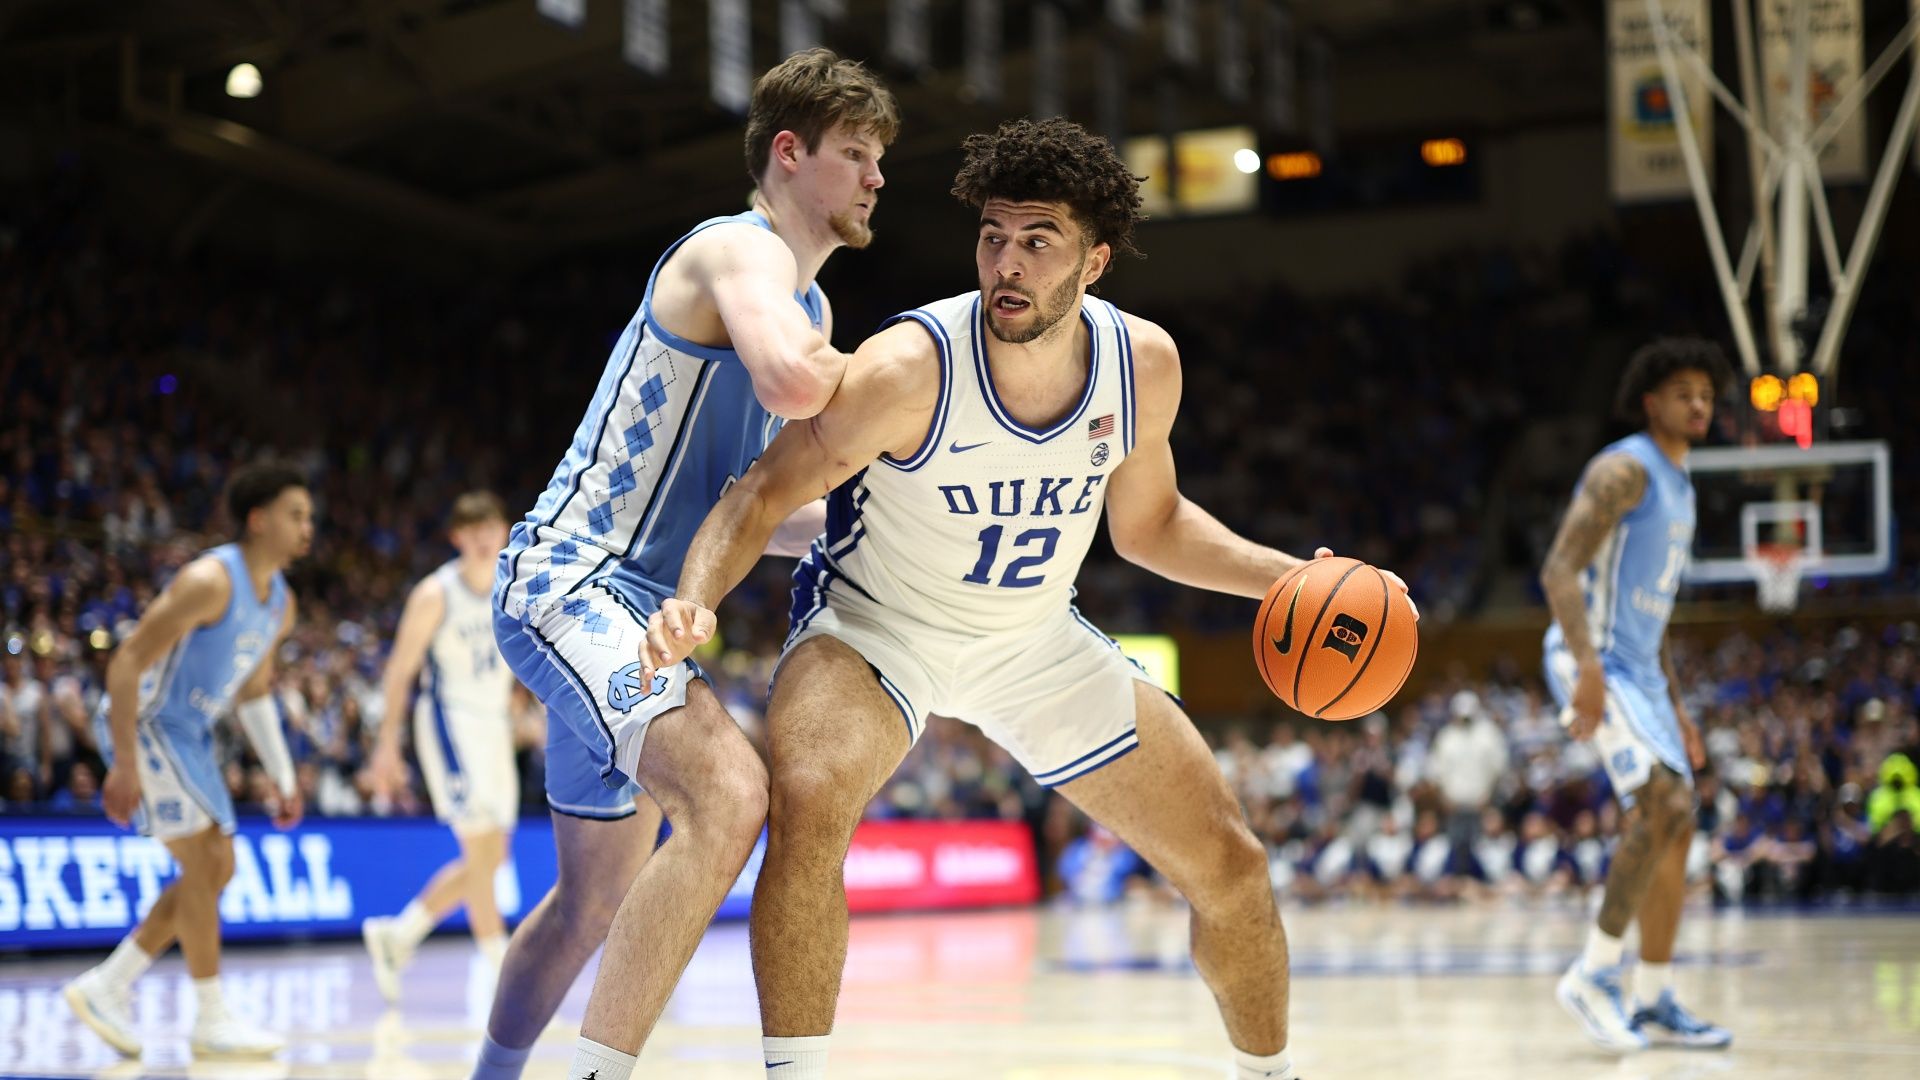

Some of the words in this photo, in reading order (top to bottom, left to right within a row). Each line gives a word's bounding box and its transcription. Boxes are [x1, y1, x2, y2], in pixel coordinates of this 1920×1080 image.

[938, 474, 1104, 516] DUKE
[962, 524, 1062, 588] 12
[0, 834, 352, 931] KETALL
